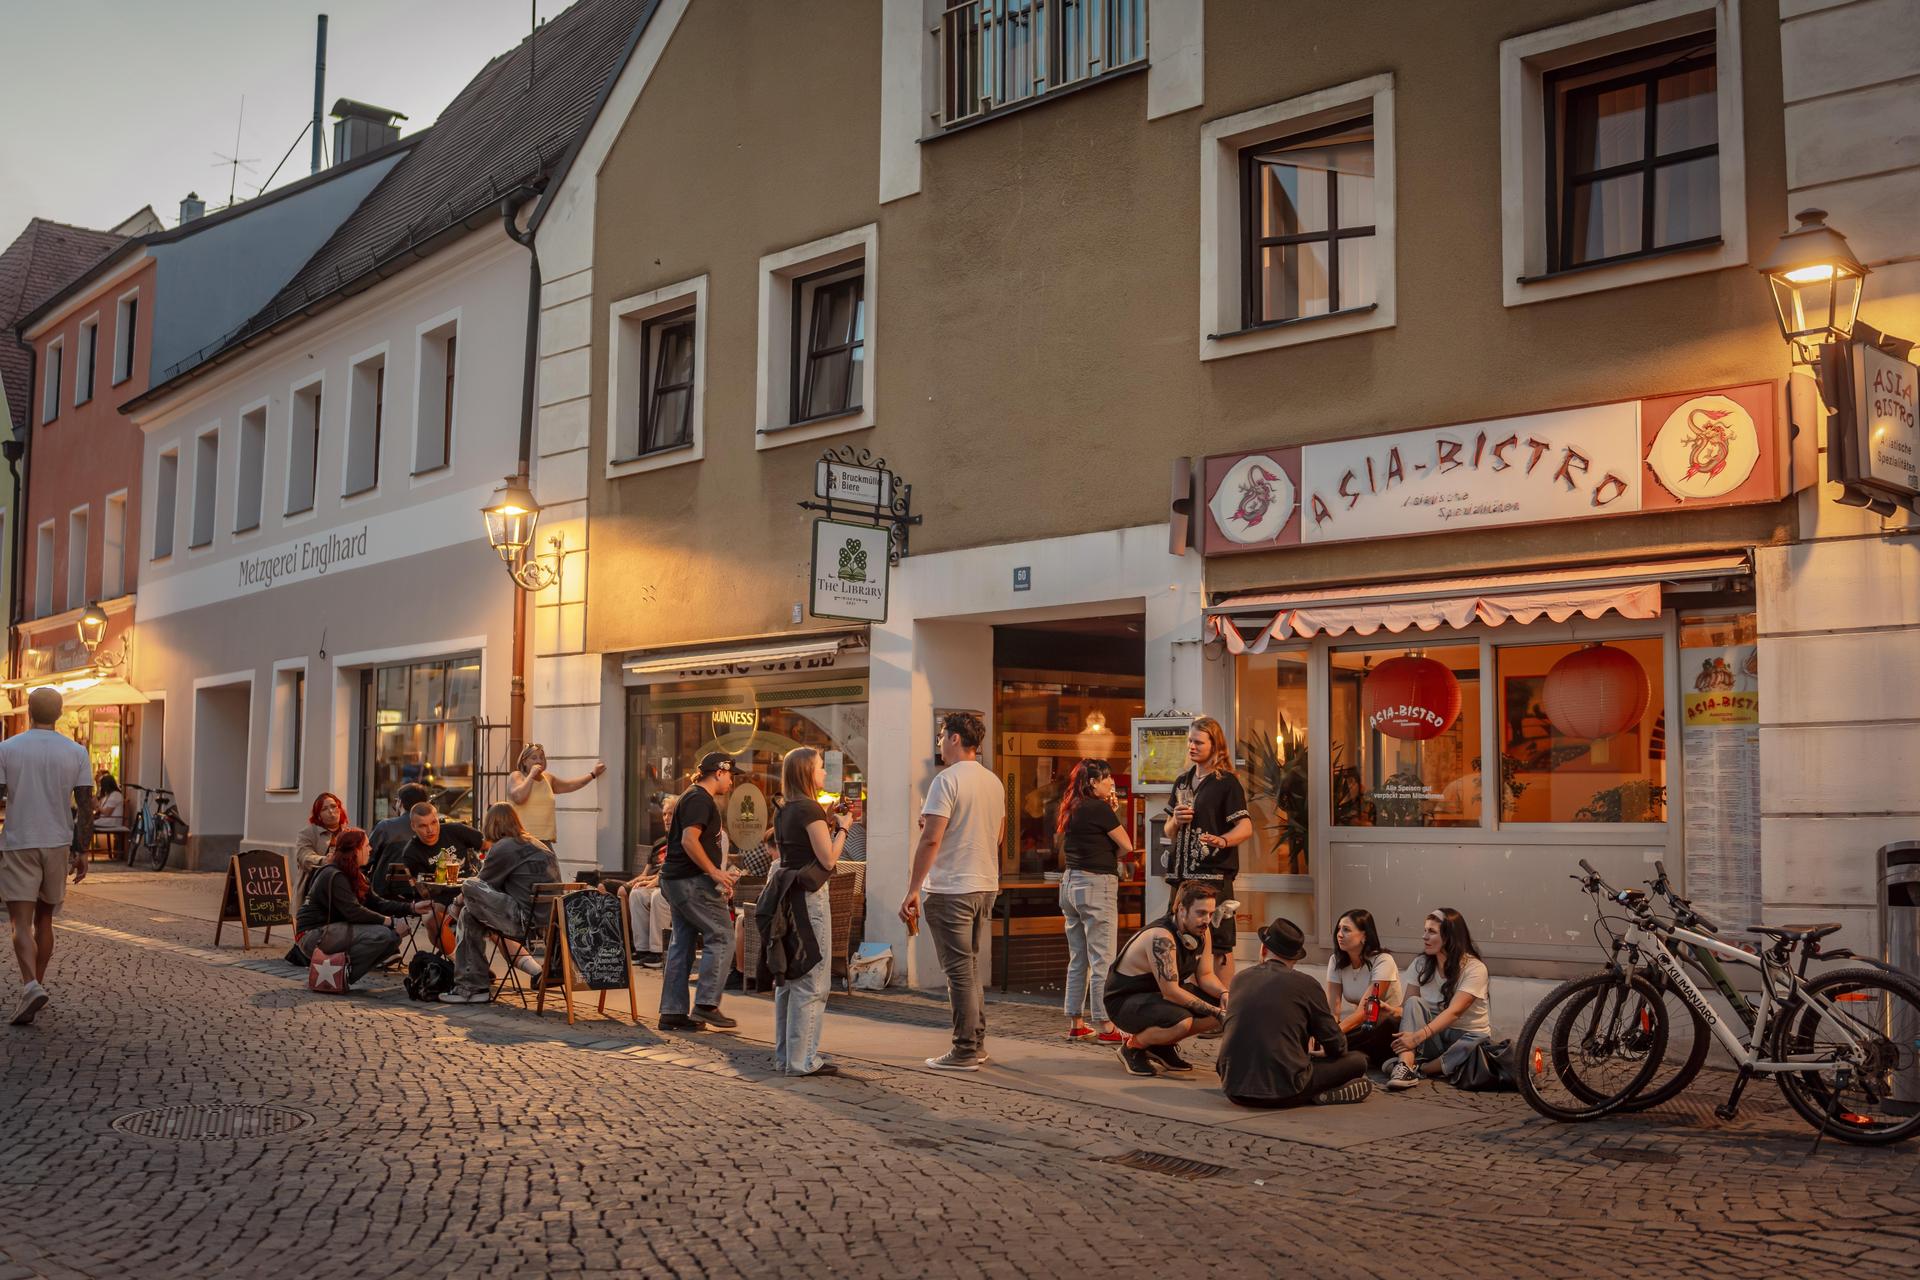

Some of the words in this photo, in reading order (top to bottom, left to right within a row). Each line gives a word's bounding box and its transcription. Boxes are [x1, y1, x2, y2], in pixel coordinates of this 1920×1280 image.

[1873, 368, 1912, 406] ASIA
[1875, 398, 1914, 428] BISTRO
[1880, 435, 1912, 455] Aiatische
[841, 480, 860, 492] Biere
[1311, 430, 1628, 528] ASIA-BISTRO
[238, 544, 298, 588] Metzgerei
[301, 526, 368, 574] Englhard
[1017, 569, 1027, 581] 60
[712, 709, 754, 725] GUINNESS
[1369, 704, 1444, 729] ASIA-BISTRO
[1373, 792, 1398, 800] verpackt
[1385, 784, 1398, 792] Alle
[1397, 784, 1421, 793] Speisen
[1421, 784, 1433, 793] gut
[248, 866, 281, 880] PUB
[246, 880, 288, 896] QUIZ
[249, 898, 275, 912] Every
[1667, 966, 1717, 1025] KILIMANJARO
